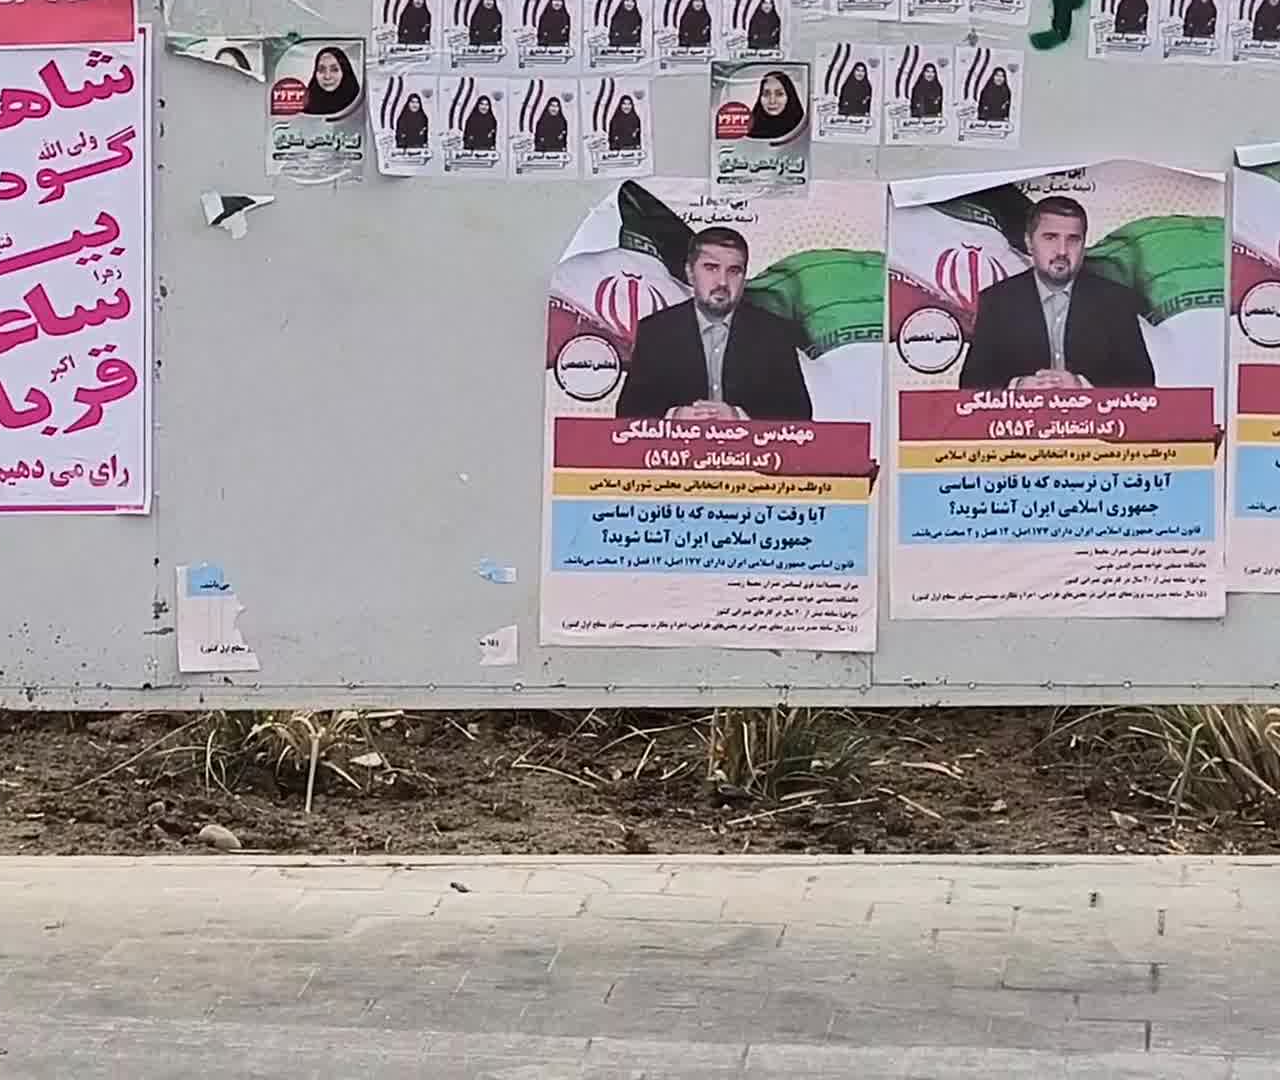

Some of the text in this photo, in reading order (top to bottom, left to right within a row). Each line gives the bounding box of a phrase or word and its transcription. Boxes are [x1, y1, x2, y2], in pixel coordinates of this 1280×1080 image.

[93, 267, 123, 287] زهرا
[49, 353, 77, 383] اکبر
[955, 389, 1158, 416] مهندس حمید عبدالملکی
[611, 420, 815, 447] مهندس حمید عبدالملکی
[1038, 418, 1095, 439] انتخاباتی
[89, 454, 131, 488] رای
[693, 451, 750, 469] انتخاباتی
[49, 463, 85, 489] می
[592, 504, 826, 525] آیا وقت آن نرسیده که با قانون اساسی
[601, 528, 813, 550] جمهوری اسلامی ایران آشنا شوید؟
